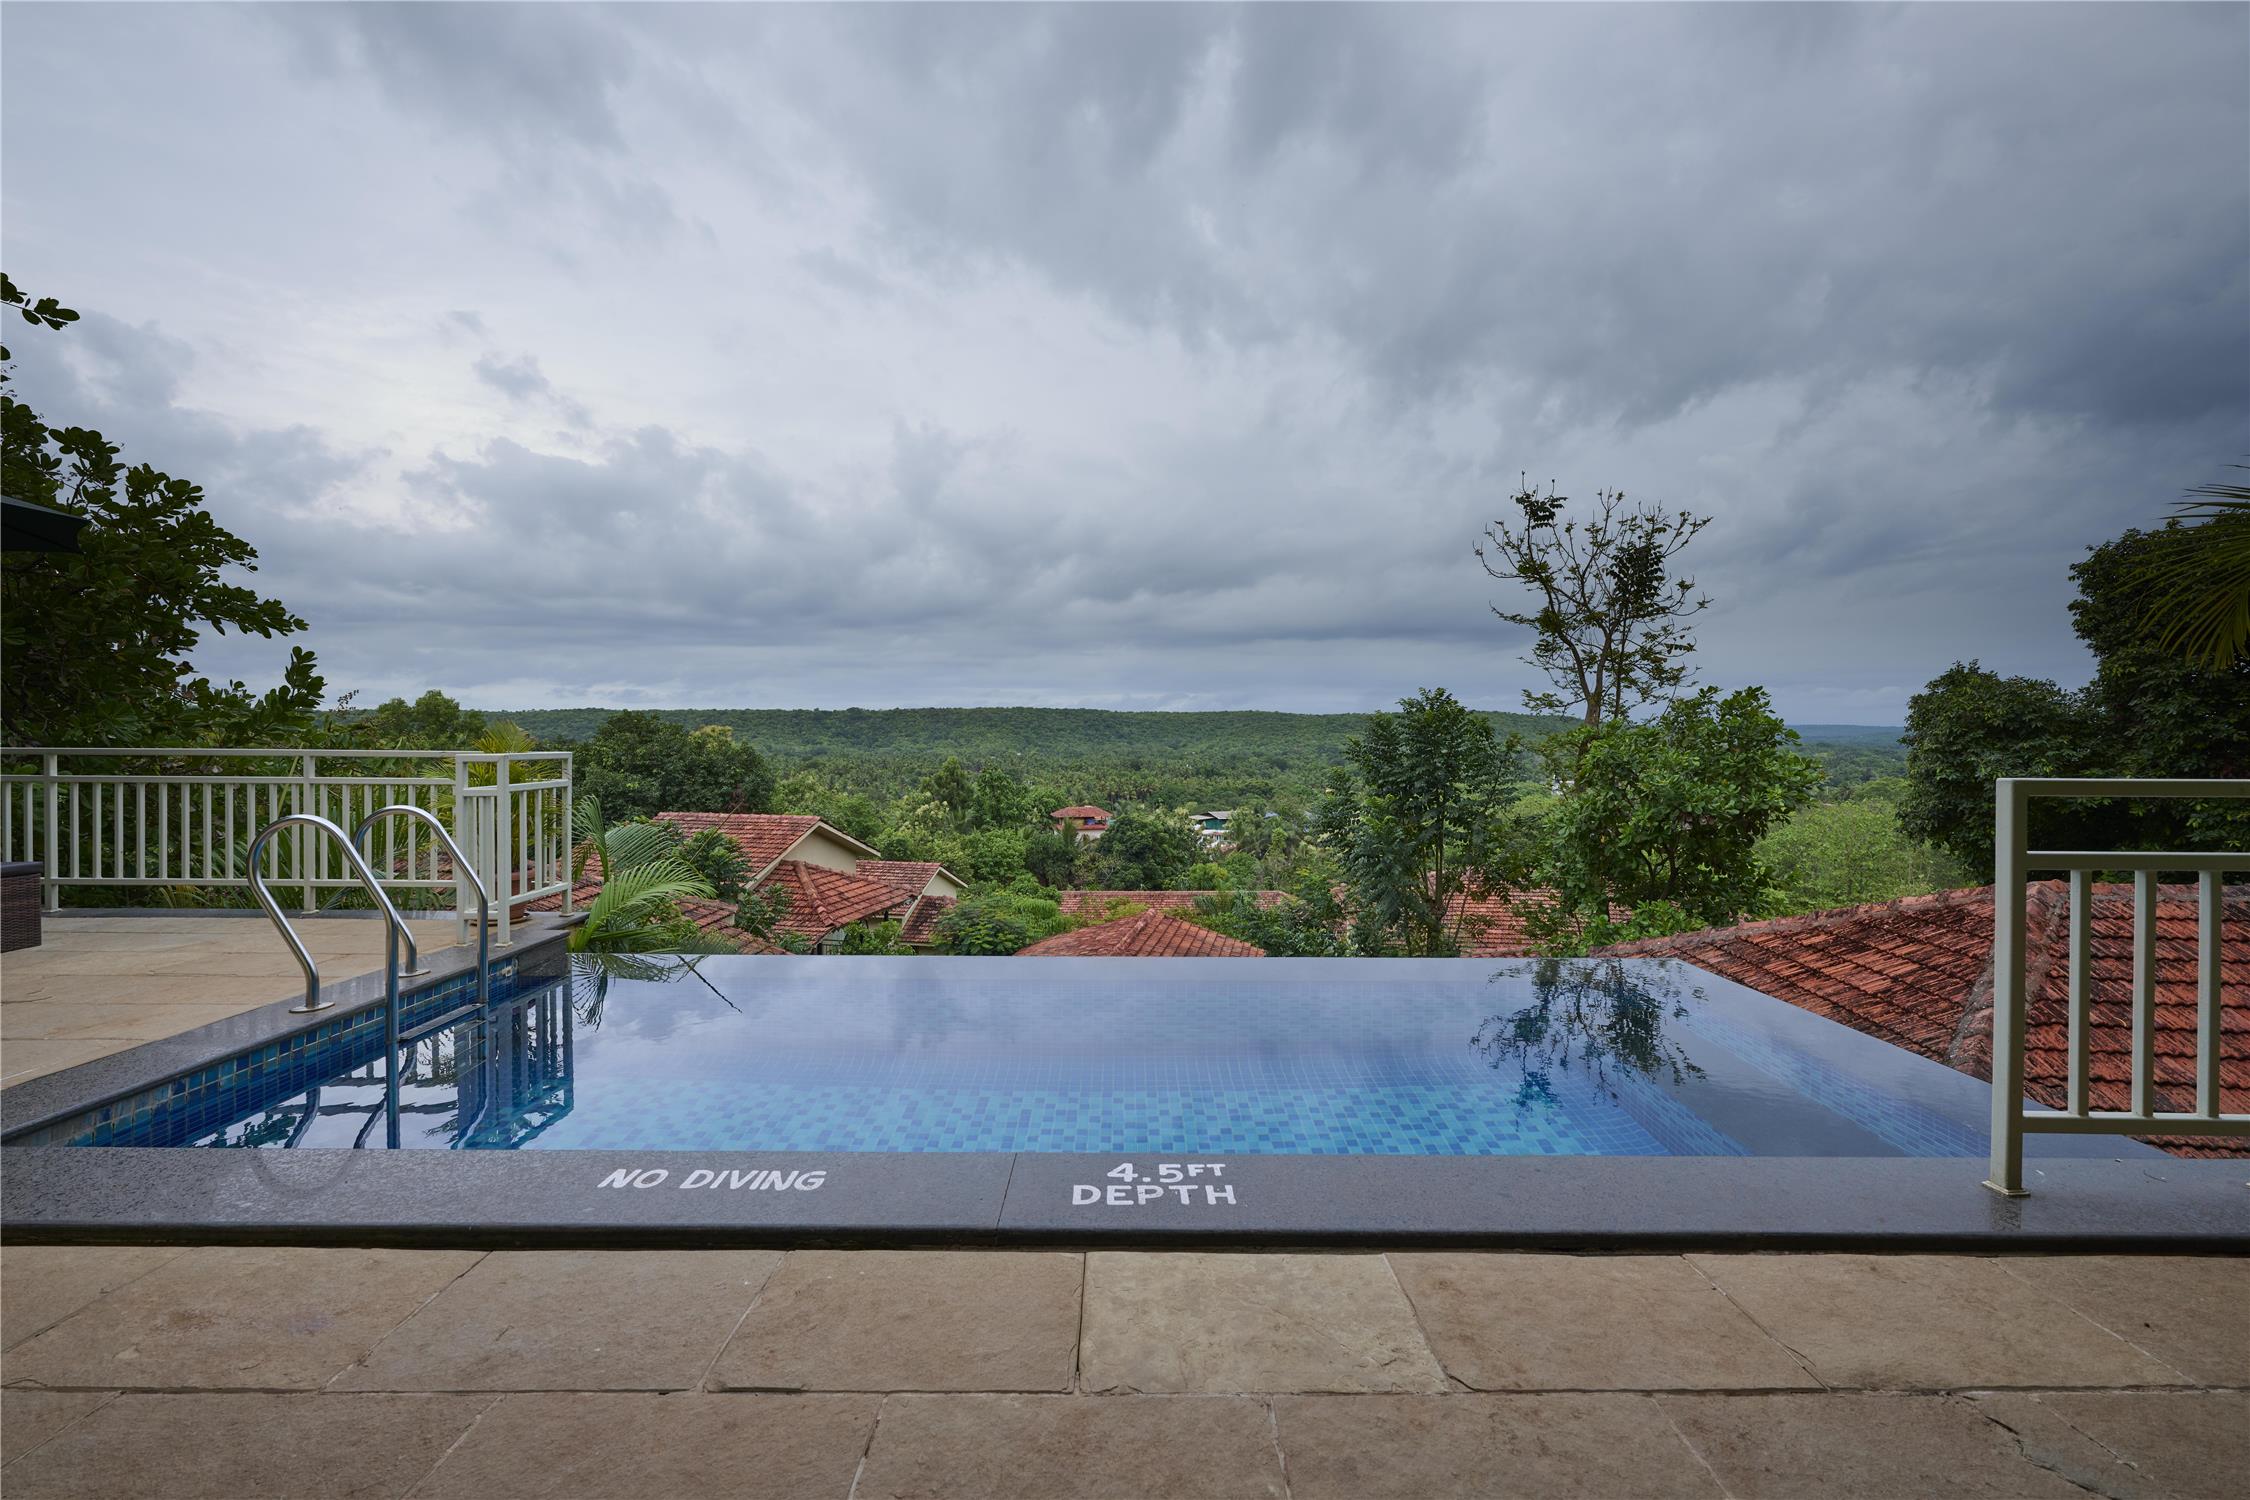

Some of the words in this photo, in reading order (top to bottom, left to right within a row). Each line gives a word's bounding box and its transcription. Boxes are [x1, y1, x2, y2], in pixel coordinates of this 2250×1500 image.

[597, 1168, 668, 1189] NO
[680, 1169, 827, 1191] DIVING
[1106, 1162, 1226, 1183] 4.5FT
[1072, 1184, 1237, 1206] DEPTH
